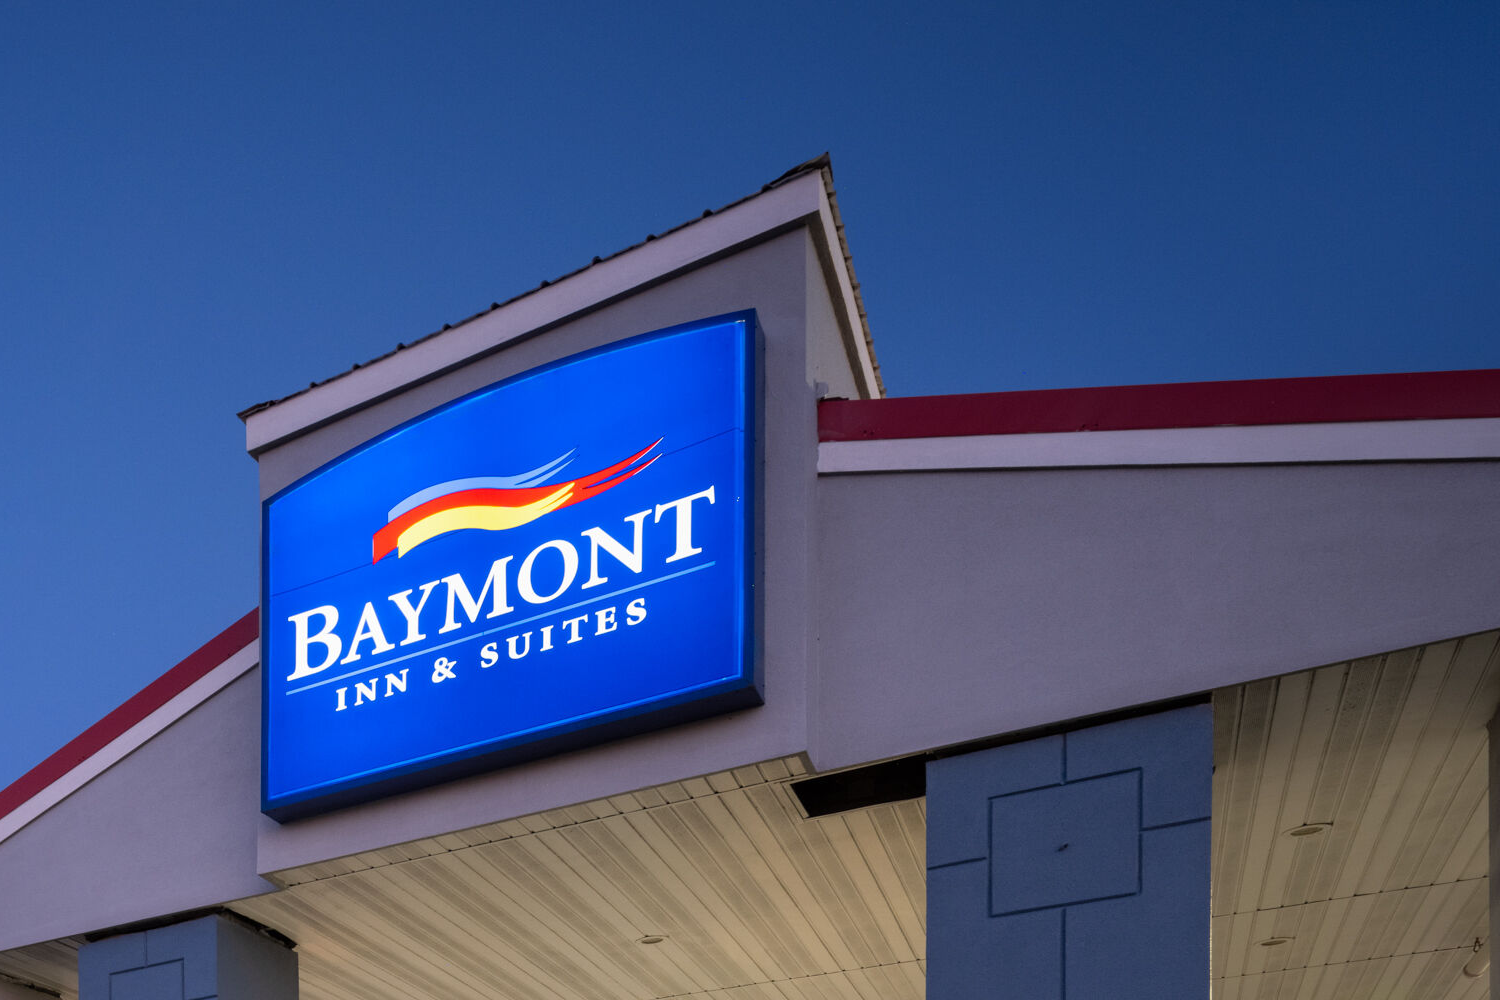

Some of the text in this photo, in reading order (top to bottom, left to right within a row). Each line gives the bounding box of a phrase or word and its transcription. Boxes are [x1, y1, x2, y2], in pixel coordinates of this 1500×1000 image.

[286, 485, 716, 682] BAYMONT
[335, 597, 648, 712] INN & SUITES
